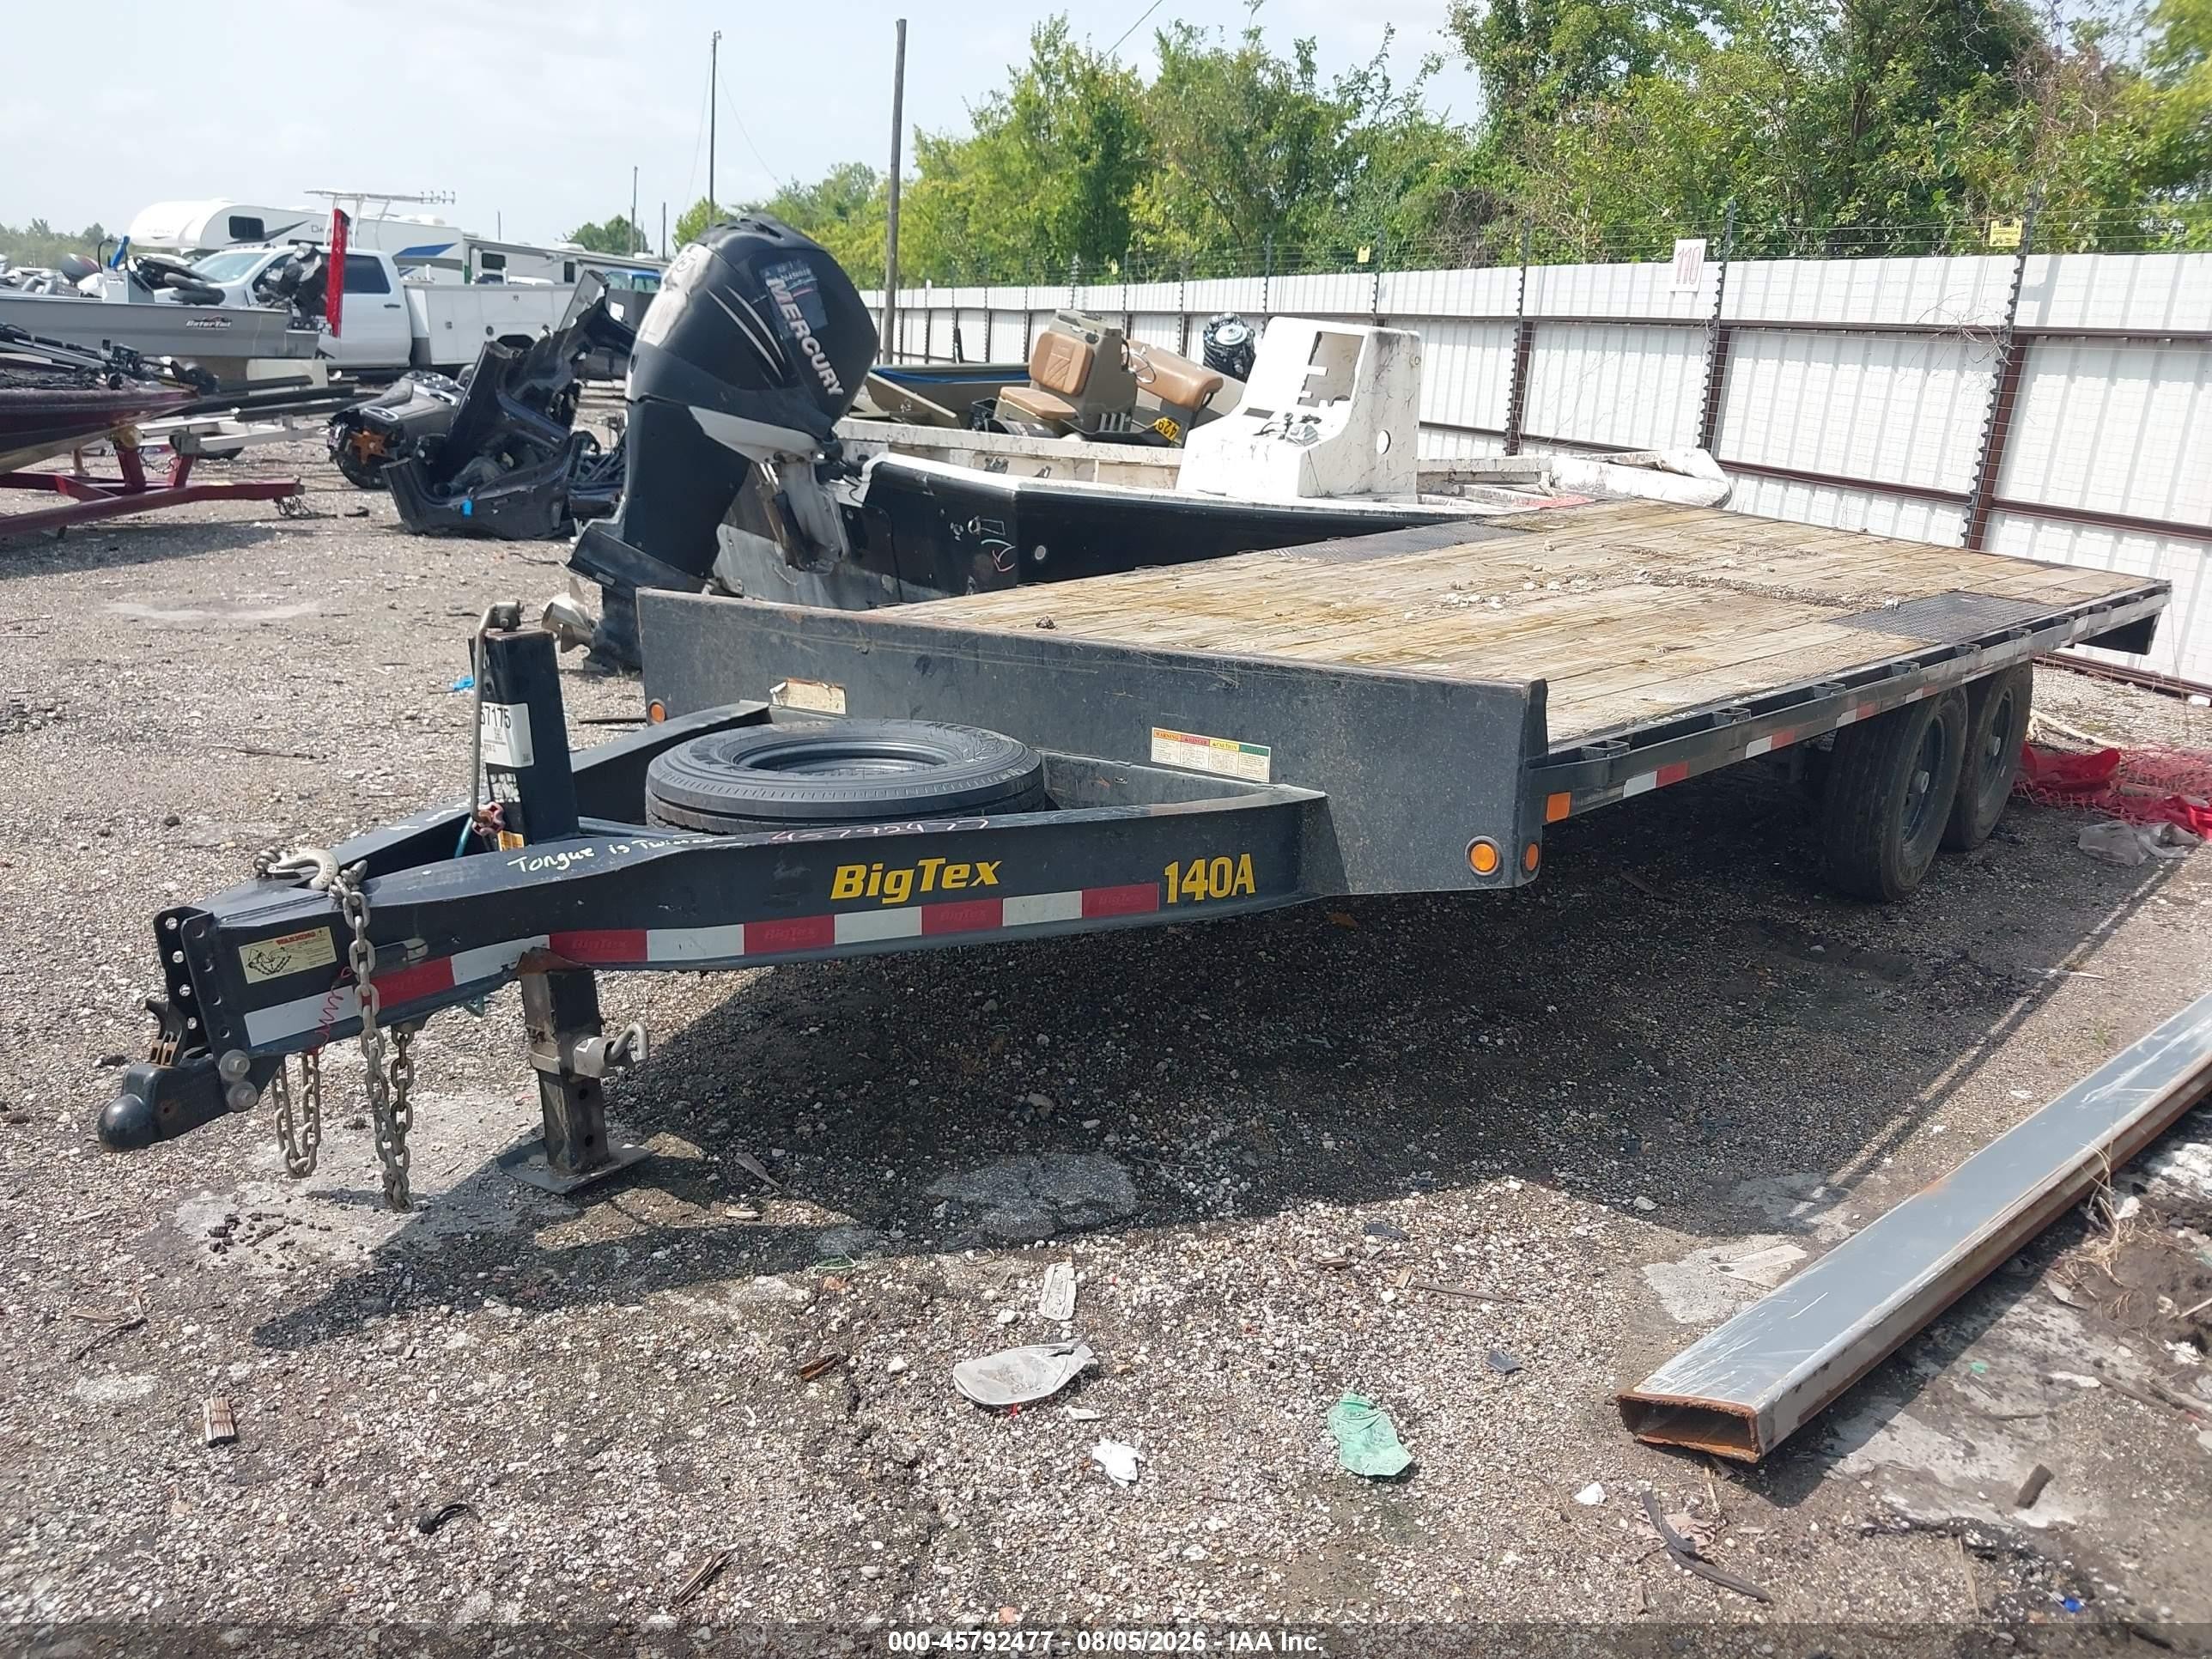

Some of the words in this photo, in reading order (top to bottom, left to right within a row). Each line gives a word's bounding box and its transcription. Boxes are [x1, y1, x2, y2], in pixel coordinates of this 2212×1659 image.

[1676, 246, 1701, 284] 110
[766, 278, 845, 397] MERCURY
[1155, 732, 1179, 740] WARNING
[1216, 741, 1237, 750] CAUTION
[507, 847, 595, 872] Tongue
[608, 843, 631, 855] is
[830, 857, 1003, 904] BigTex
[1164, 852, 1256, 903] 140A
